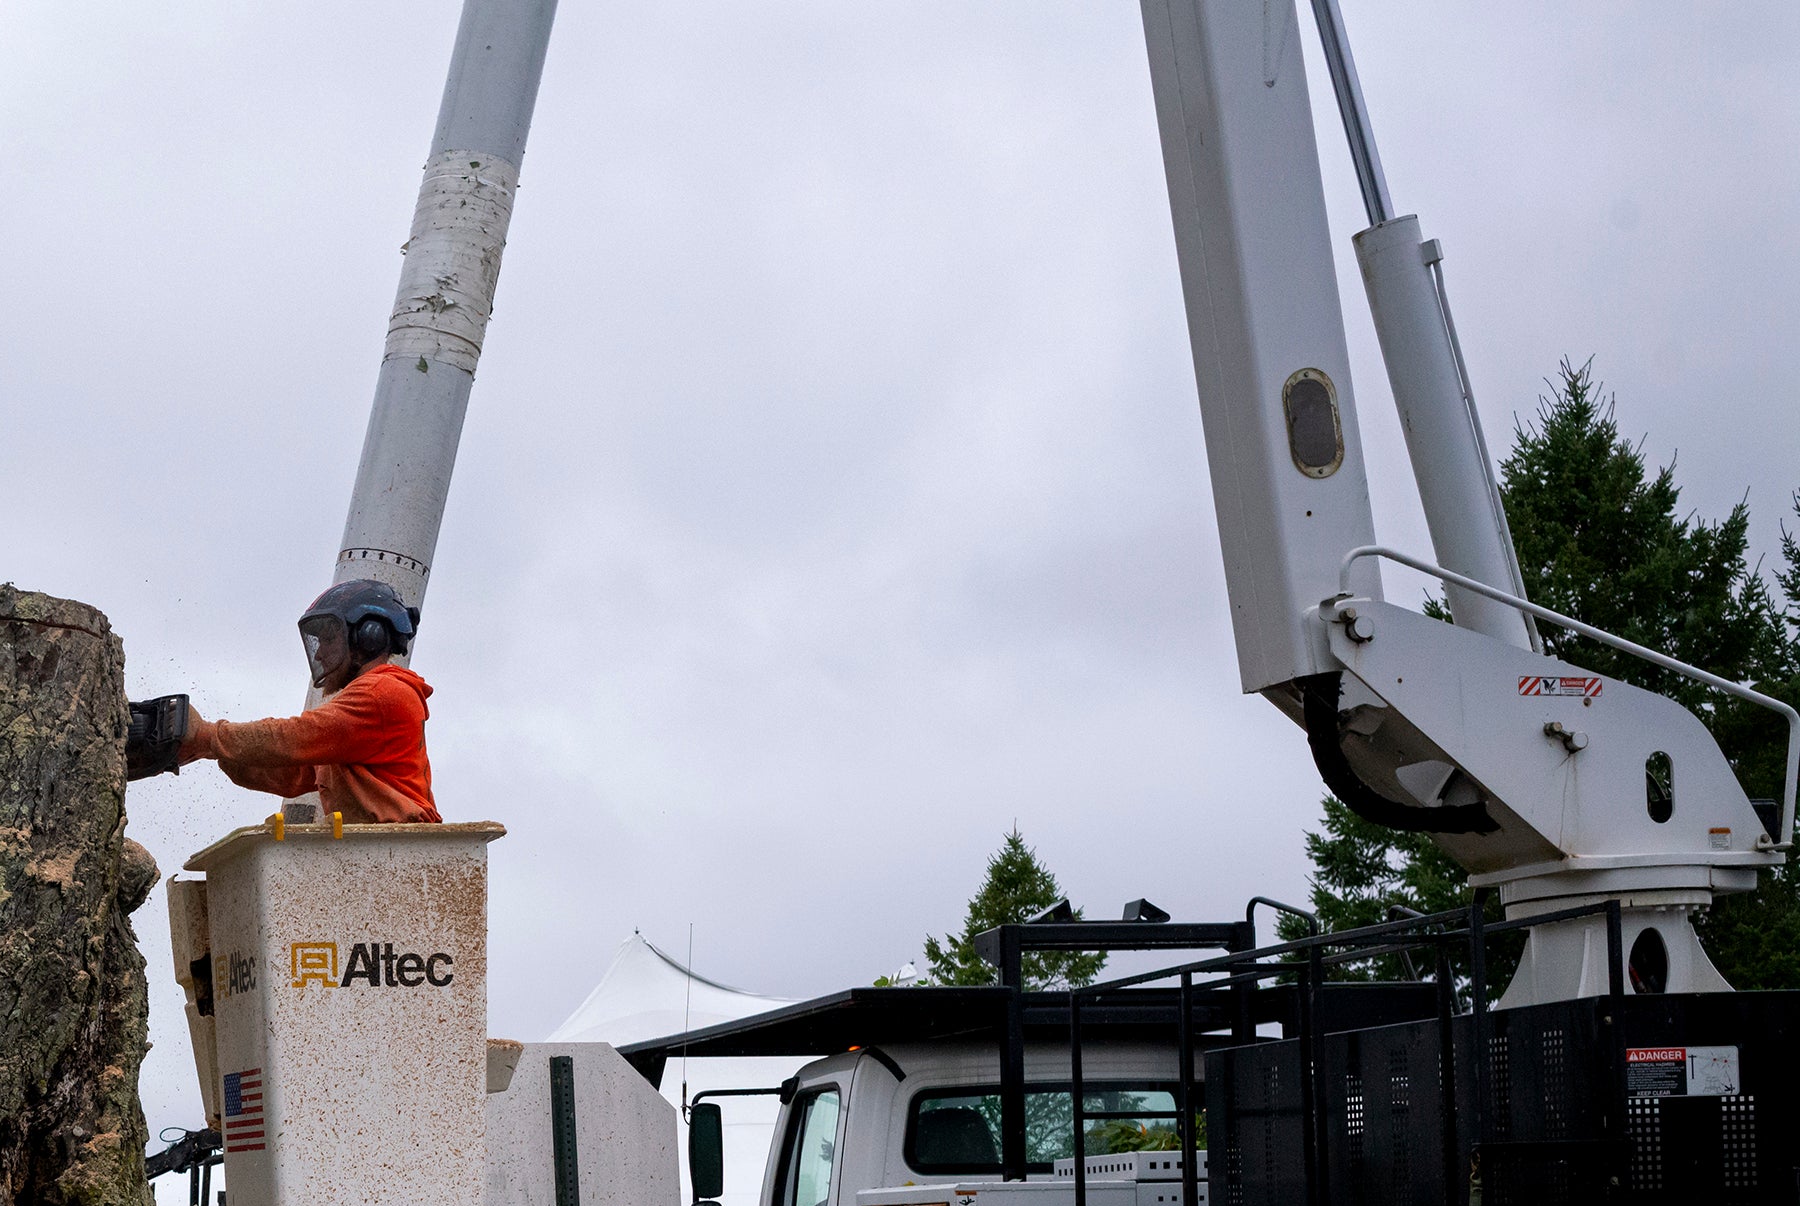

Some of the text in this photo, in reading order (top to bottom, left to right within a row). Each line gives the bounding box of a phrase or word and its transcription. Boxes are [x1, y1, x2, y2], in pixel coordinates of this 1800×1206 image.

[229, 950, 257, 996] Altec
[341, 943, 454, 987] Altec
[1639, 1051, 1682, 1060] DANGER
